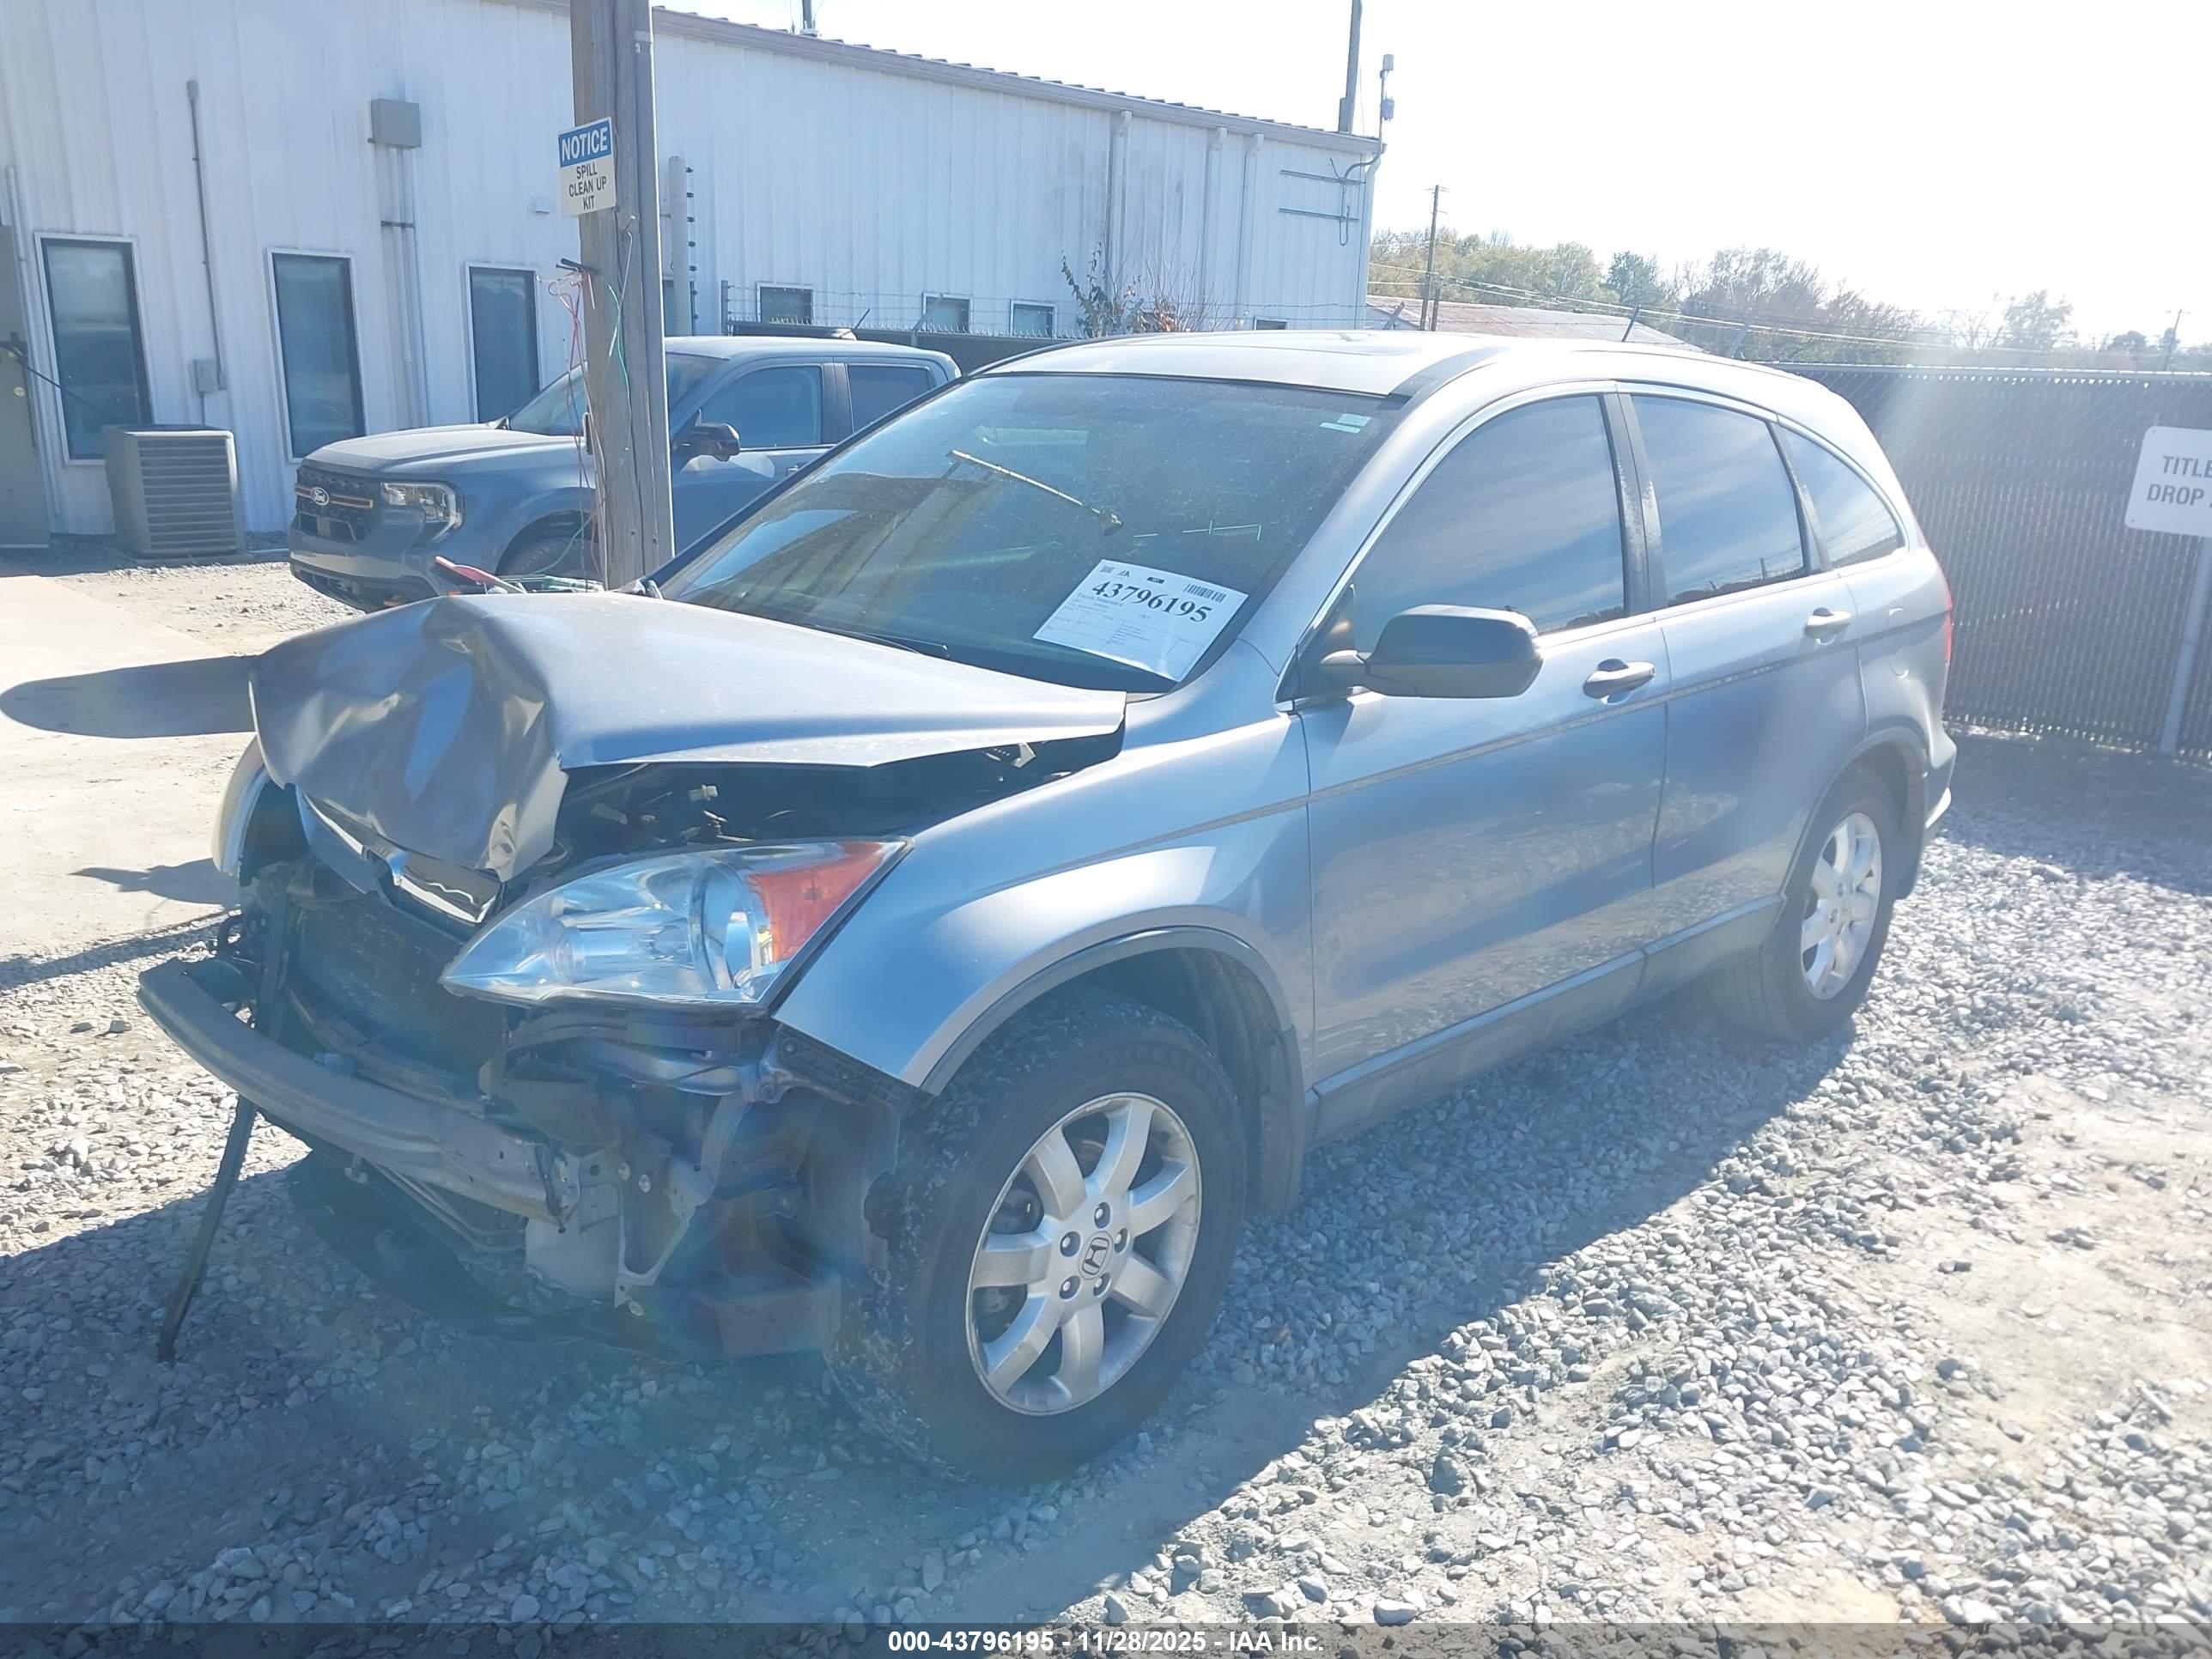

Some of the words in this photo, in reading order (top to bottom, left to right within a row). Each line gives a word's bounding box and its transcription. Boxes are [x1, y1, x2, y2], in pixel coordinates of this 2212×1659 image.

[562, 127, 607, 162] NOTICE
[576, 161, 598, 179] SPILL
[568, 180, 593, 198] CLEAN
[596, 175, 607, 191] UP
[582, 195, 595, 210] KIT
[2146, 483, 2205, 506] DROP
[1091, 580, 1214, 623] 43796195
